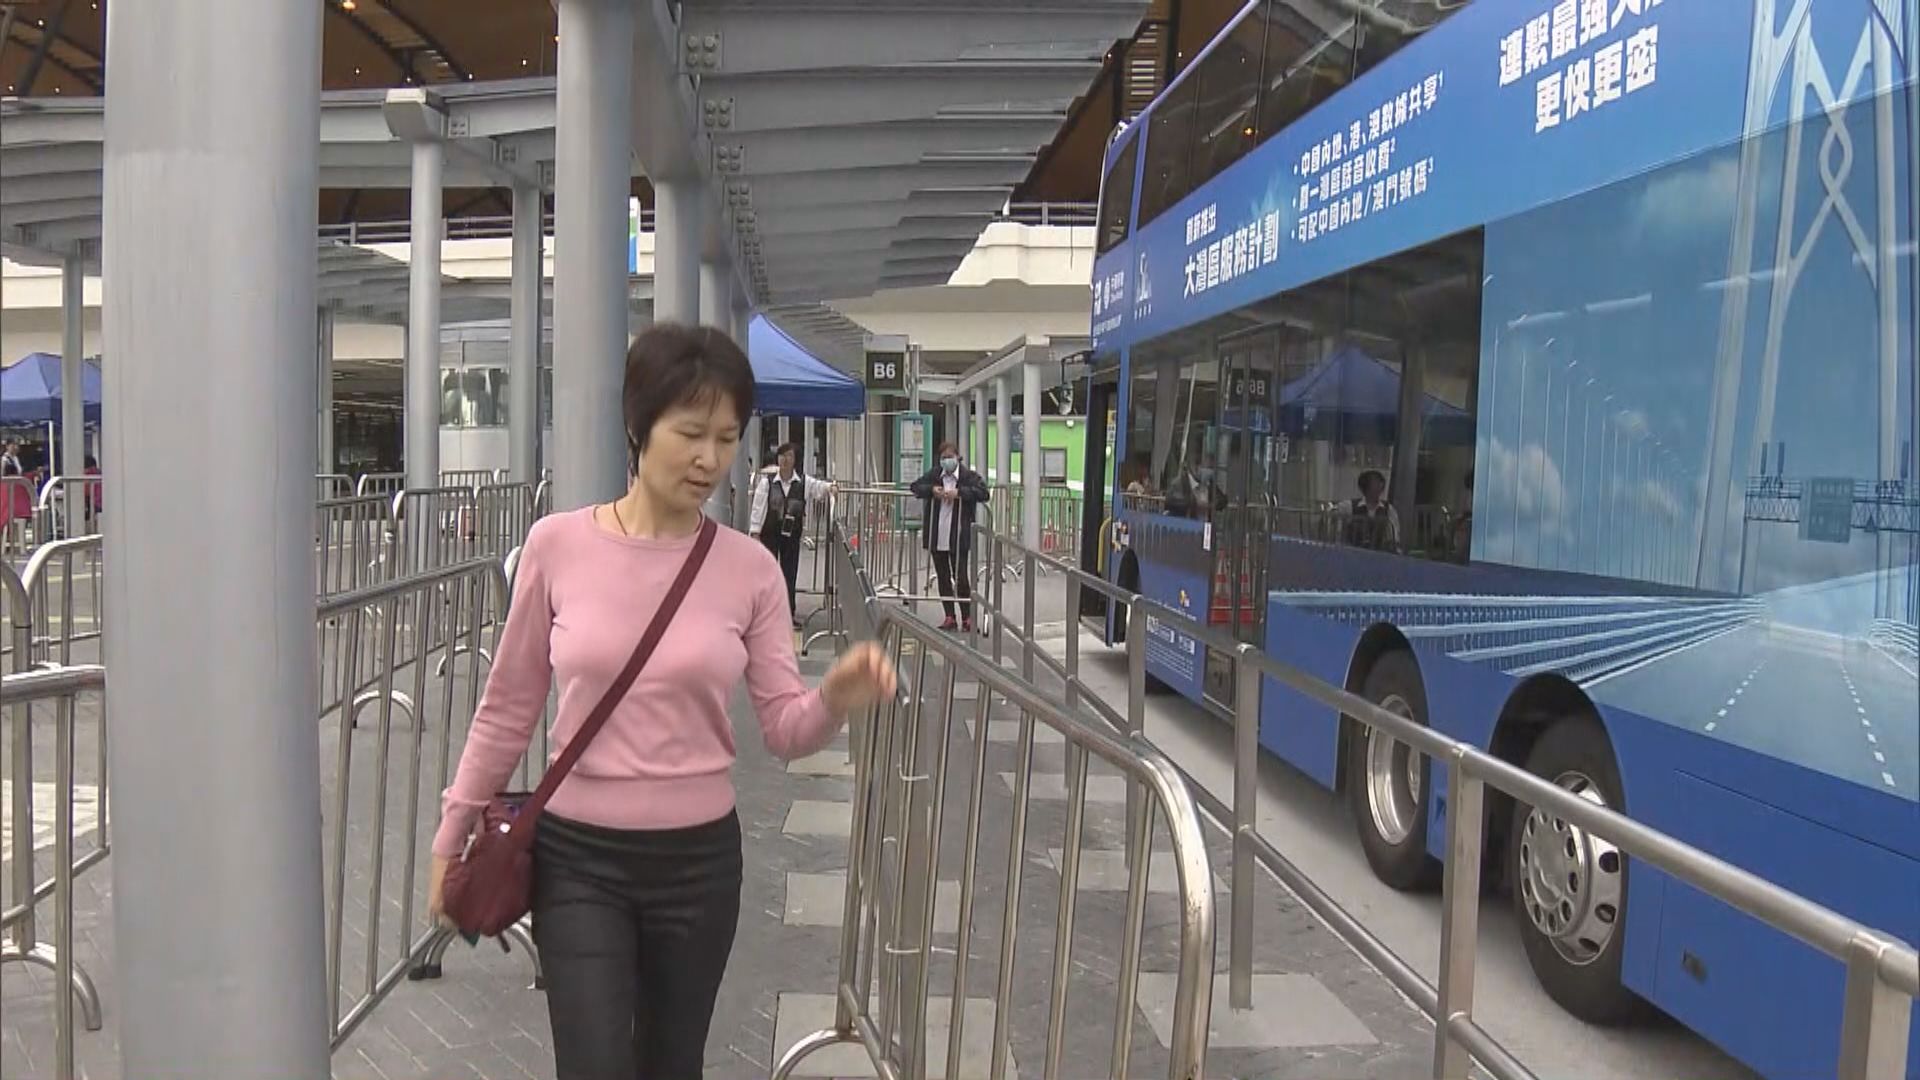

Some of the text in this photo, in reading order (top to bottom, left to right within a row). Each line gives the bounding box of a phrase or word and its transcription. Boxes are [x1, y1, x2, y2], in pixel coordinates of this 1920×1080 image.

[1535, 24, 1658, 133] 更快更密
[1184, 208, 1279, 300] 大灣區服務計劃
[873, 362, 896, 379] B6
